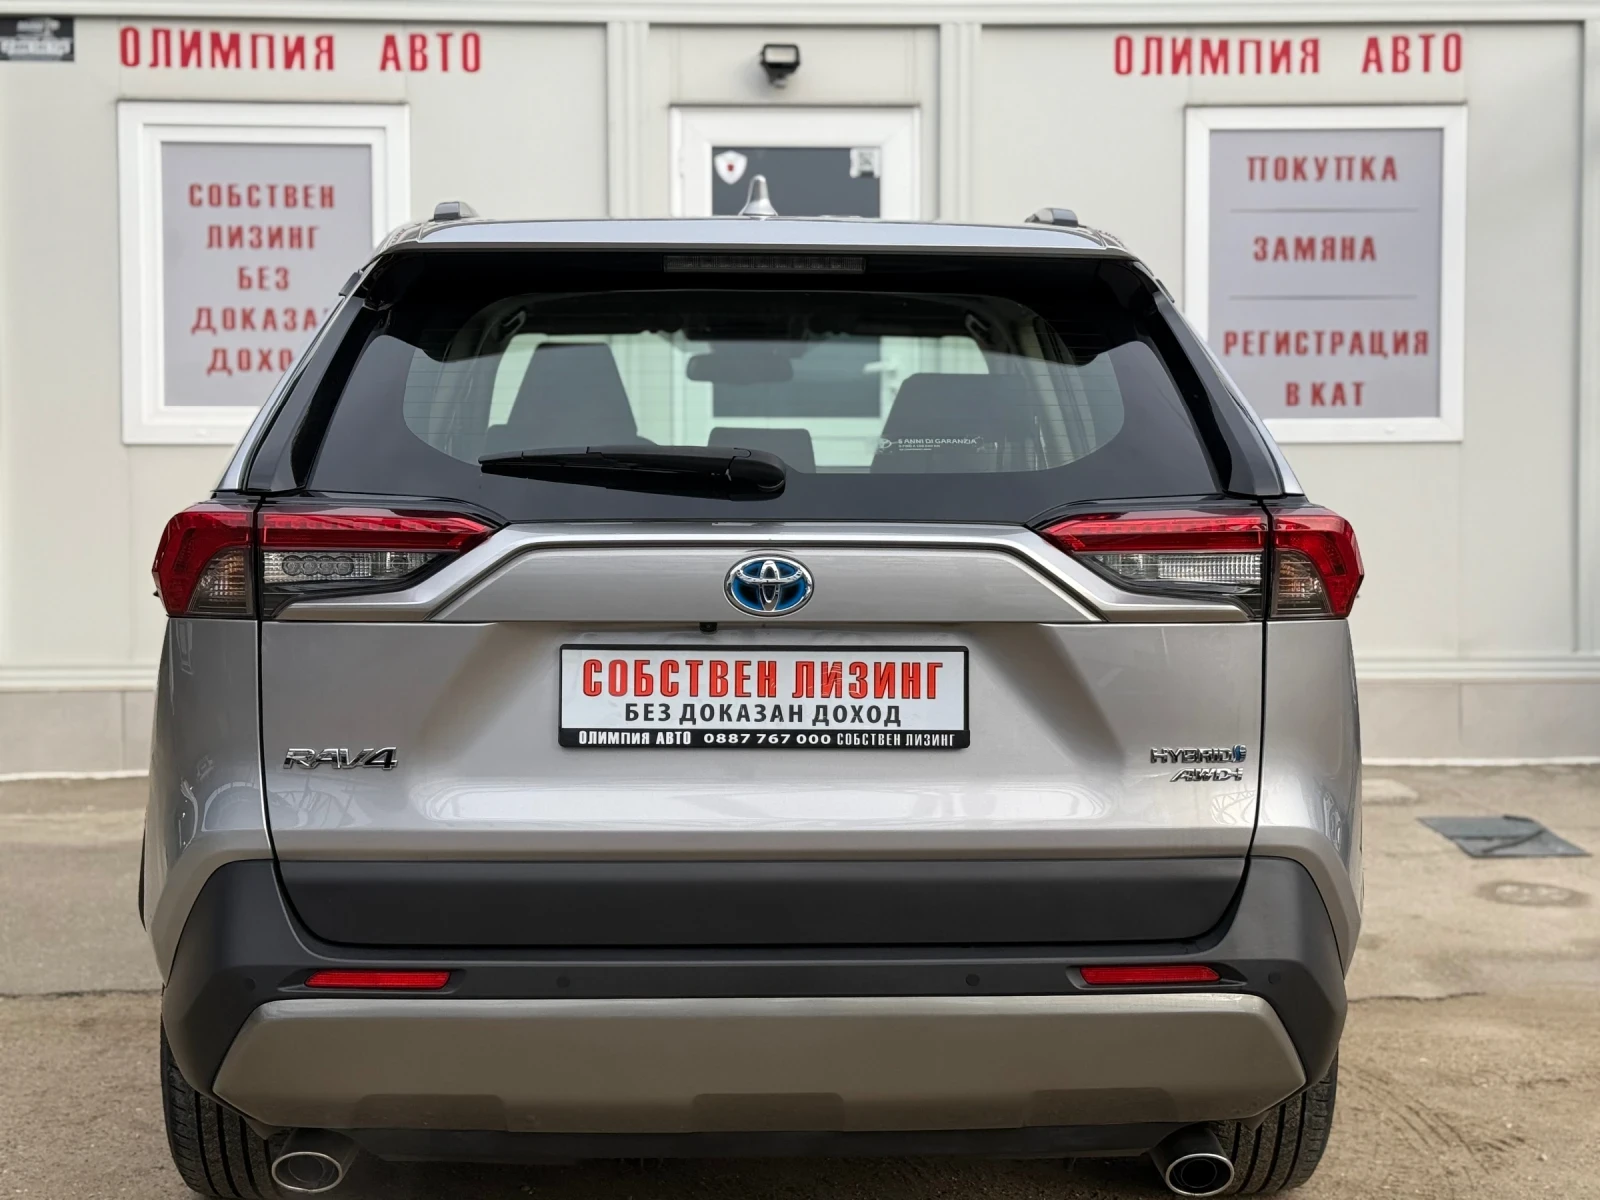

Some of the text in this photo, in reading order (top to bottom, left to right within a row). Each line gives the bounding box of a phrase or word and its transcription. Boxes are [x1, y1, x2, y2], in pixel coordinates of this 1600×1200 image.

[119, 26, 336, 72] ОЛИМПИЯ
[379, 32, 482, 74] АВТО
[1113, 32, 1464, 76] ОЛИМПИЯ АВТО
[1246, 155, 1399, 183] ПОКУПКА
[188, 183, 336, 209] СОБСТВЕН
[206, 225, 321, 250] ЛИЗИНГ
[1253, 235, 1378, 263] ЗАМЯНА
[237, 266, 290, 291] БЕЗ
[191, 307, 329, 335] ДОКАЗА
[1223, 330, 1430, 359] РЕГИСТРАЦИЯ
[206, 347, 295, 377] ДОХО
[1285, 382, 1366, 408] В КАТ
[582, 658, 943, 700] СОБСТВЕН ЛИЗИНГ
[625, 703, 902, 727] БЕЗ ДОКАЗАН ДОХОД
[578, 730, 956, 747] ОЛИМПИЯ АВТО 0887 767 000 СОБСТВЕН ЛИЗИНГ
[283, 746, 398, 770] RAV4
[1150, 747, 1233, 764] HYBRID
